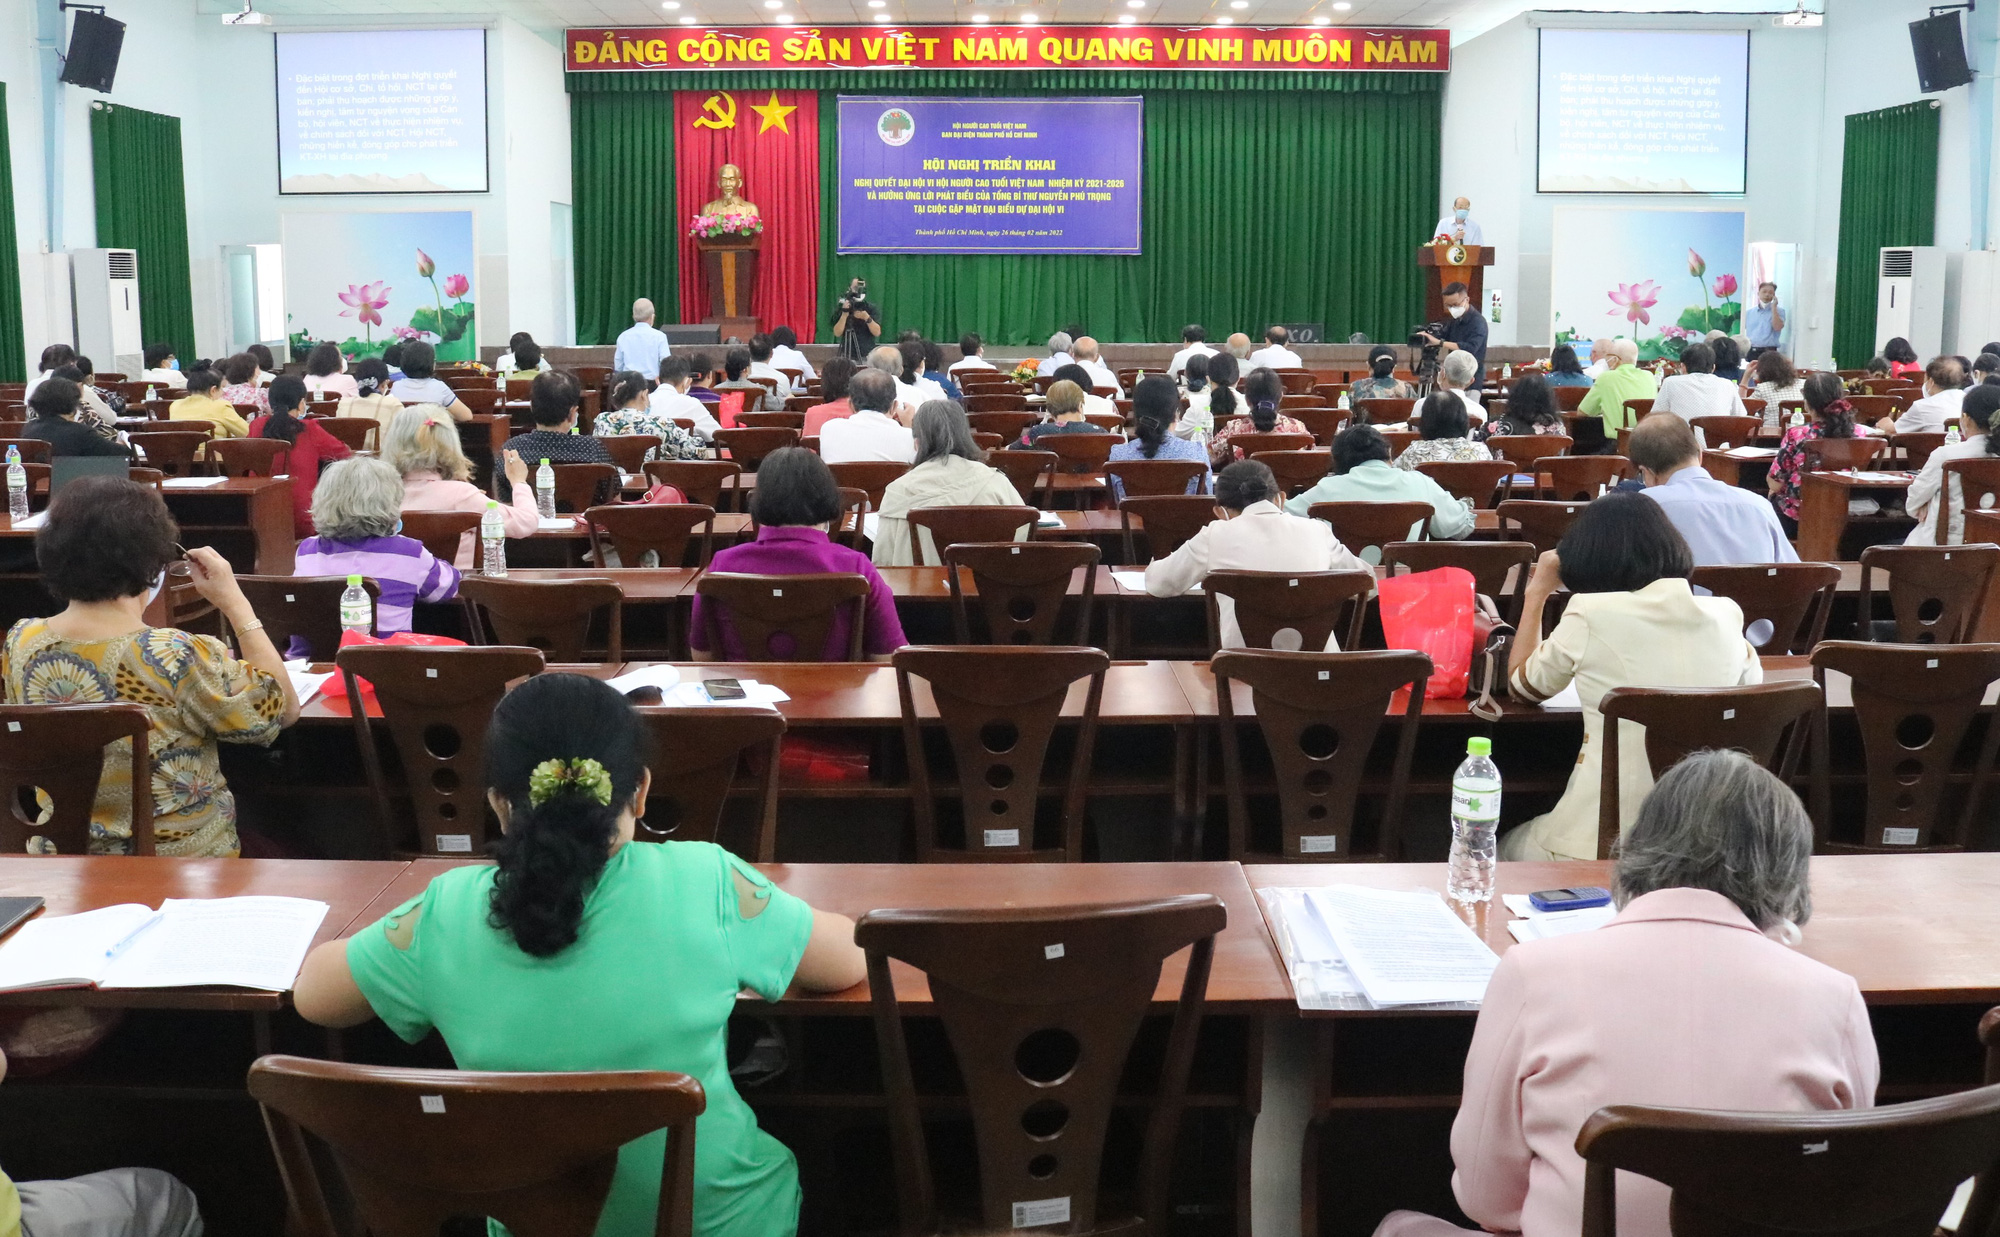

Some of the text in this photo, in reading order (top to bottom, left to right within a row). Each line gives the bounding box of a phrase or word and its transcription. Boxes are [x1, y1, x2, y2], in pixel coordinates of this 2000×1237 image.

[574, 29, 1438, 67] ĐẢNG CỘNG SẢN VIỆT NAM QUANG VINH MUÔN NĂM
[923, 155, 1056, 172] HỘI NGHỊ TRIỂN KHAI
[854, 176, 1125, 189] NGHỊ QUYẾT ĐẠI HỘI VI HỘI NGƯỜI CAO TUỔI VIỆT NAM NHIỆM KỲ 2021-2026
[914, 202, 1065, 215] TẠI CUỘC GẶP MẶT ĐẠI BIỂU DỰ ĐẠI HỘI VI
